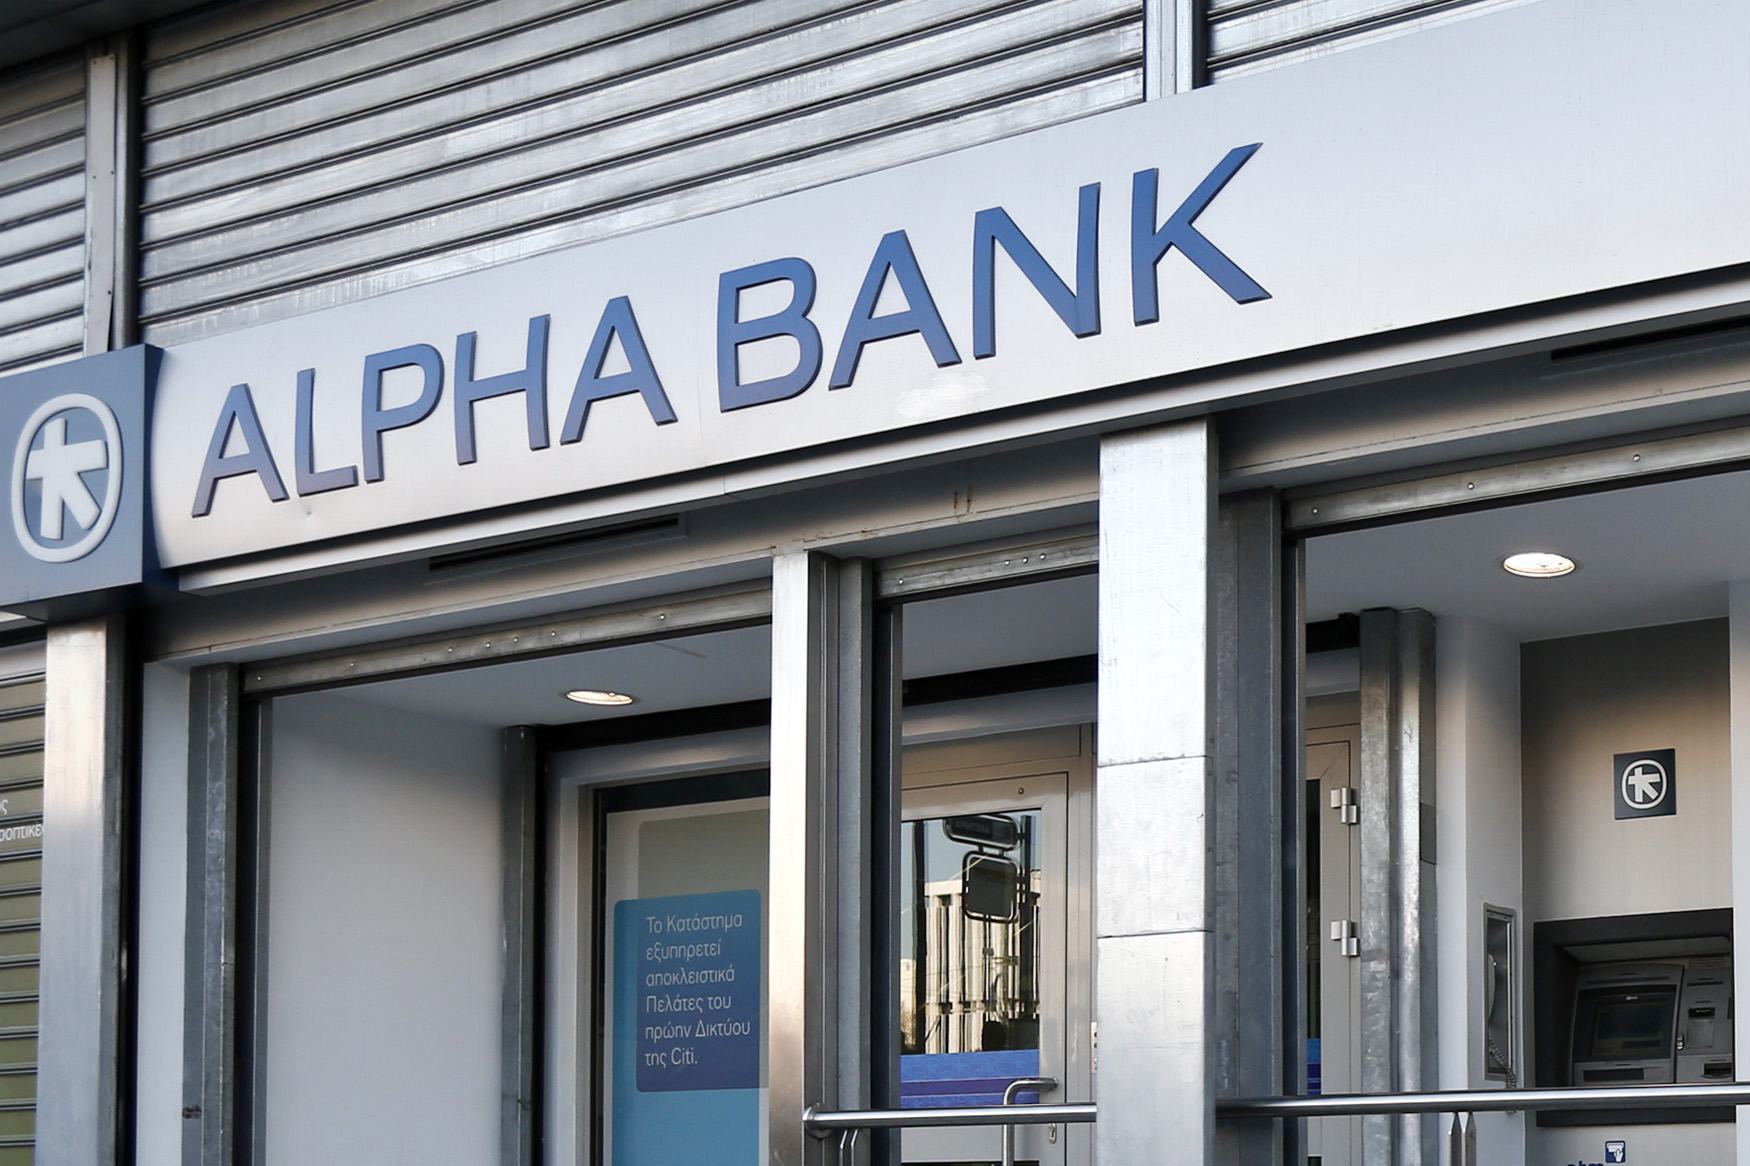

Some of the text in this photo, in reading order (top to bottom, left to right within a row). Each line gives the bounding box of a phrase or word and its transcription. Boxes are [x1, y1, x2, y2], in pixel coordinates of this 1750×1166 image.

[191, 142, 1273, 519] ALPHA BANK
[646, 912, 743, 934] Το Κατάστημα
[646, 939, 721, 962] εξυπηρετεί
[646, 963, 735, 988] αποκλειστικά
[646, 994, 732, 1013] Πελάτες του
[645, 1019, 751, 1043] πρώην Δικτύου
[645, 1047, 698, 1068] της Citi.
